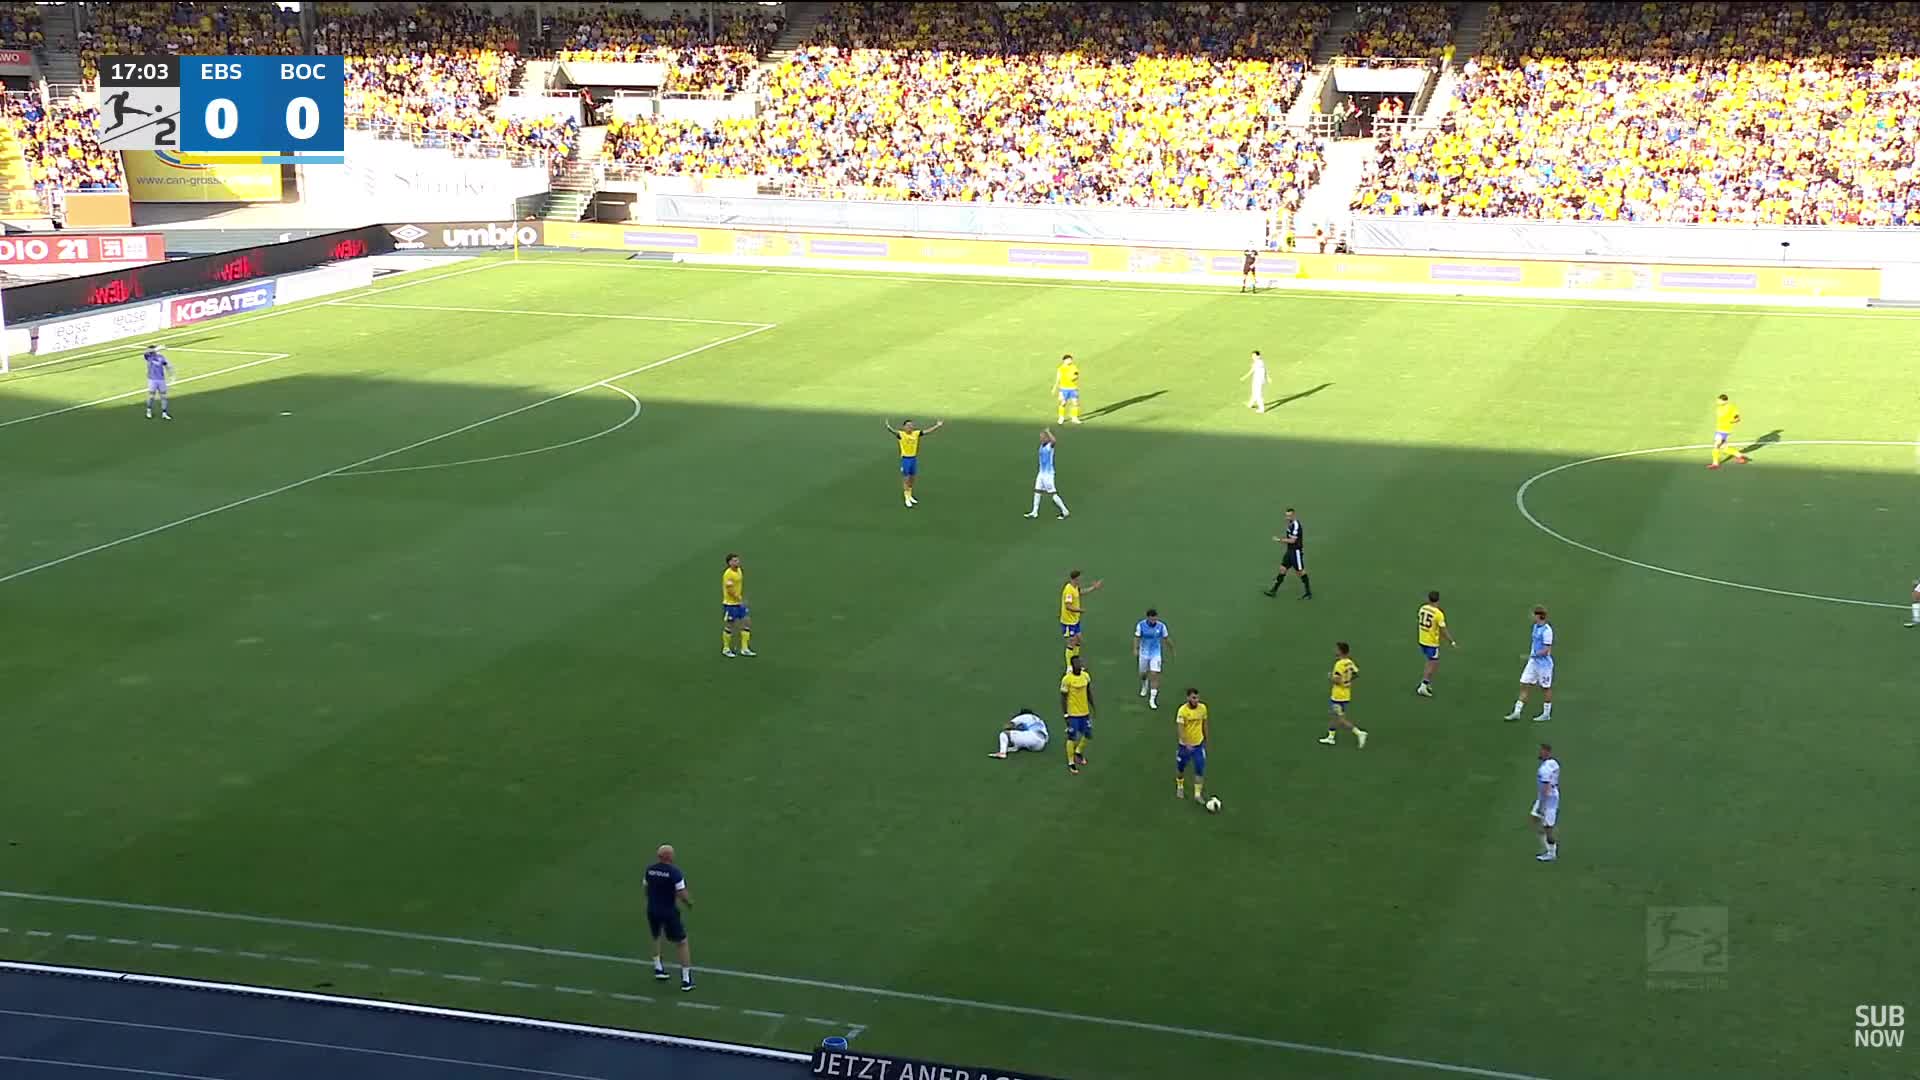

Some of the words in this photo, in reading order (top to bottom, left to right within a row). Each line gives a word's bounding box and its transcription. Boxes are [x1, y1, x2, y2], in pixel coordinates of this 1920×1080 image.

[442, 223, 538, 247] umbro
[57, 239, 89, 260] 21
[176, 288, 268, 322] KOSATEC
[1419, 611, 1433, 628] 15
[813, 1051, 892, 1080] JETZT
